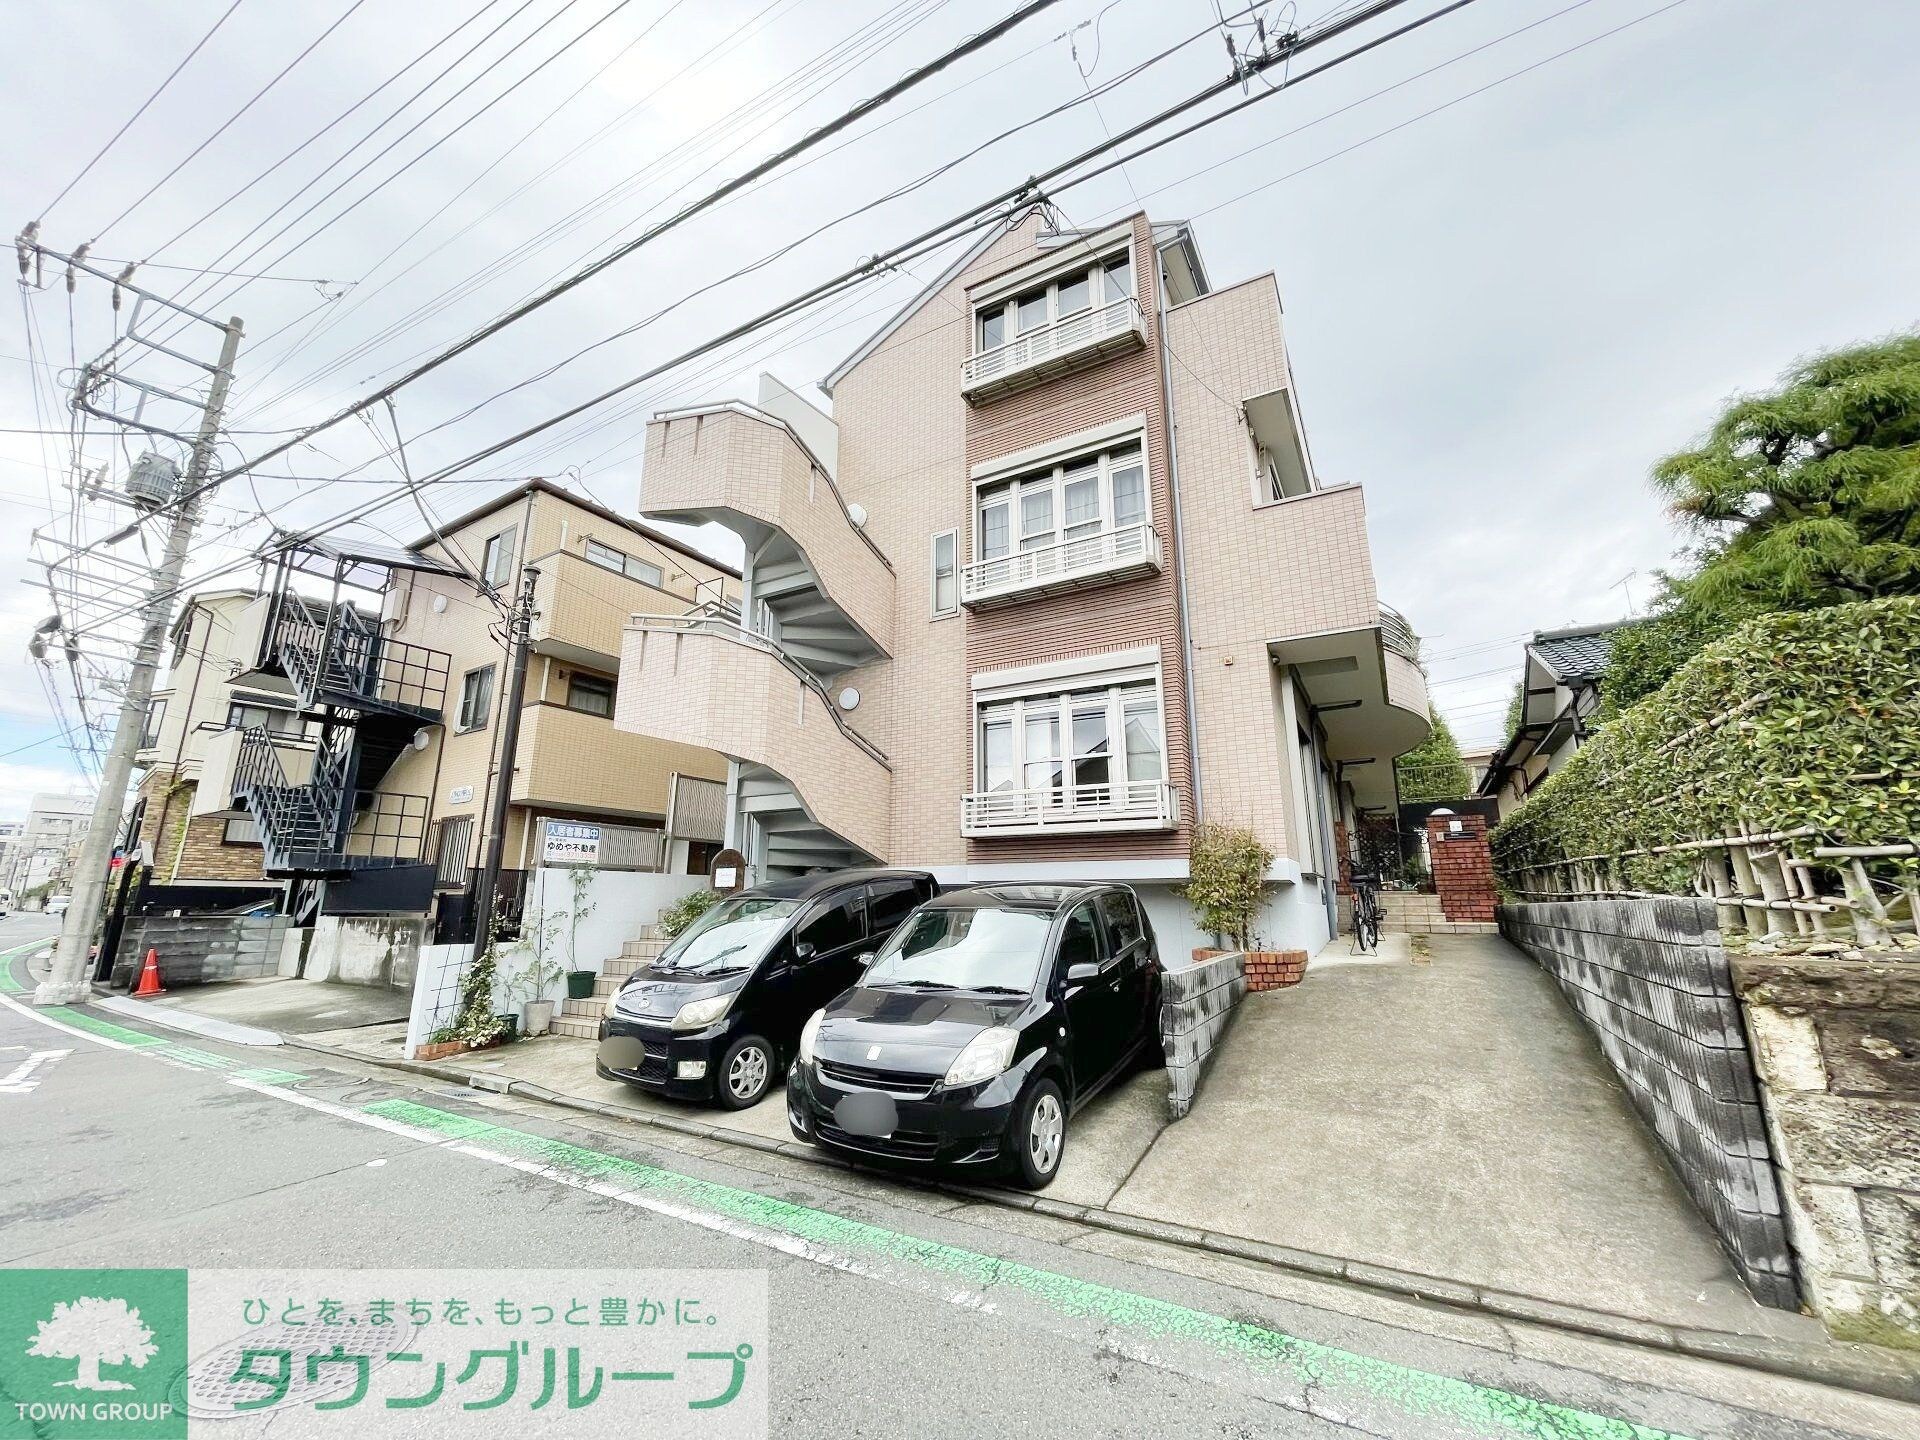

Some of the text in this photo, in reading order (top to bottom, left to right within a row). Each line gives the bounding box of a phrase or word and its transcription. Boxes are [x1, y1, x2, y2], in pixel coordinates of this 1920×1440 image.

[548, 825, 599, 839] 入居者募集中
[547, 842, 596, 852] ゆめや不動産
